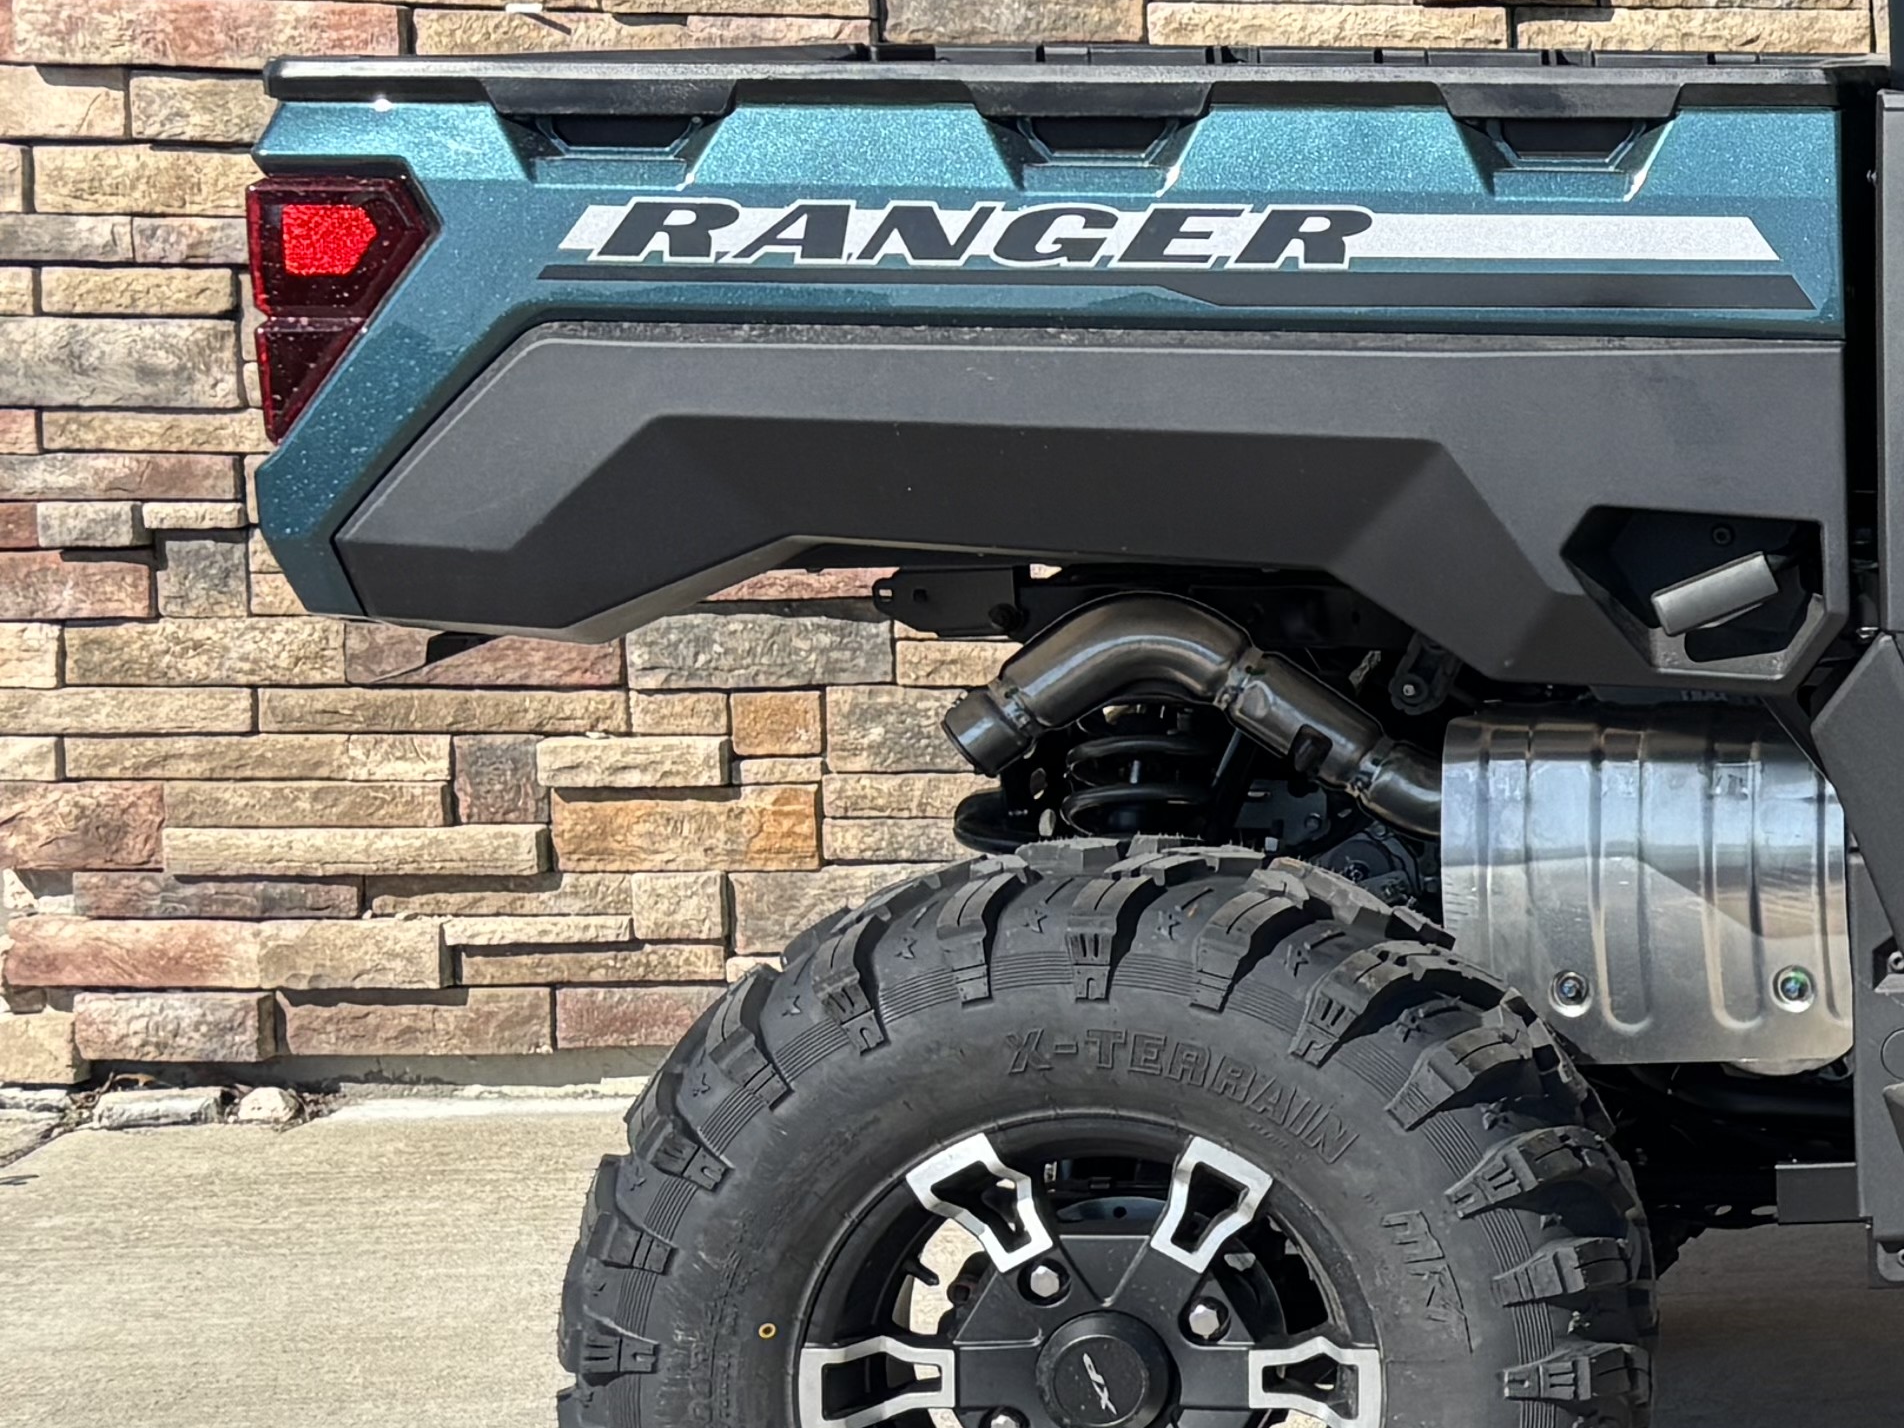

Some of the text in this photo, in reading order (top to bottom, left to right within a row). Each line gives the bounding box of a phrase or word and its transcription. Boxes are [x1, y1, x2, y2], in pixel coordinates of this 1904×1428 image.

[590, 199, 1373, 267] RANGER
[1005, 1028, 1360, 1165] X-TERRAIN
[1083, 1353, 1118, 1416] XP
